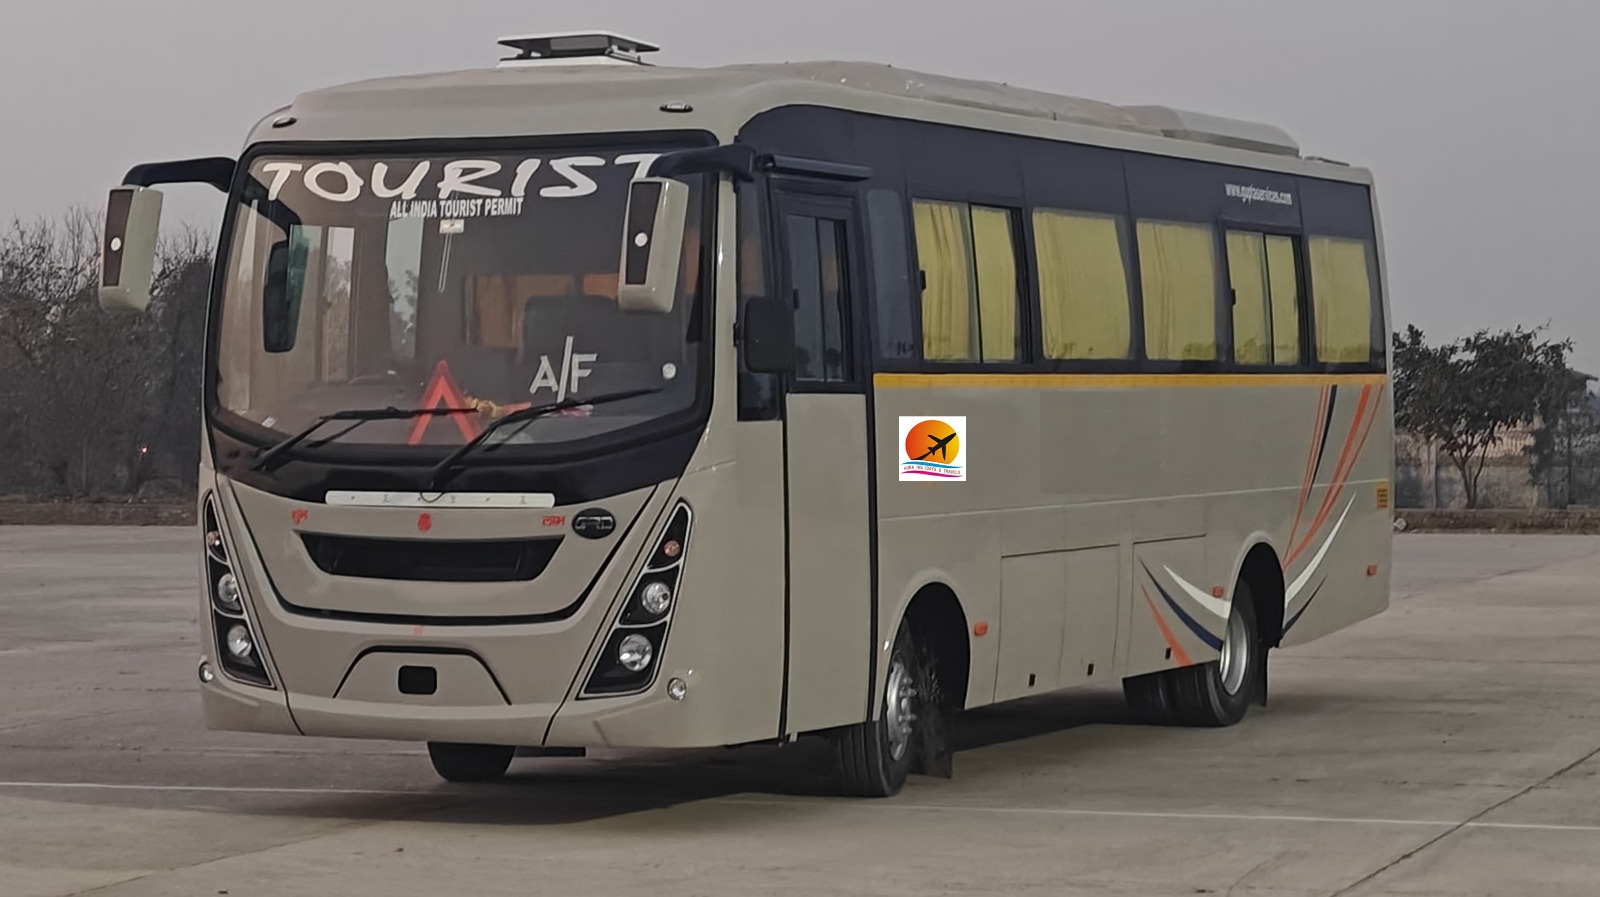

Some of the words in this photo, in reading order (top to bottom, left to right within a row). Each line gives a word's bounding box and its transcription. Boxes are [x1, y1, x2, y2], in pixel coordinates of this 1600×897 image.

[262, 153, 662, 202] TOURIST
[389, 200, 408, 219] ALL
[409, 200, 438, 218] INDIA
[439, 199, 483, 218] TOURIST
[484, 197, 524, 217] PERMIT
[529, 335, 598, 404] A/F
